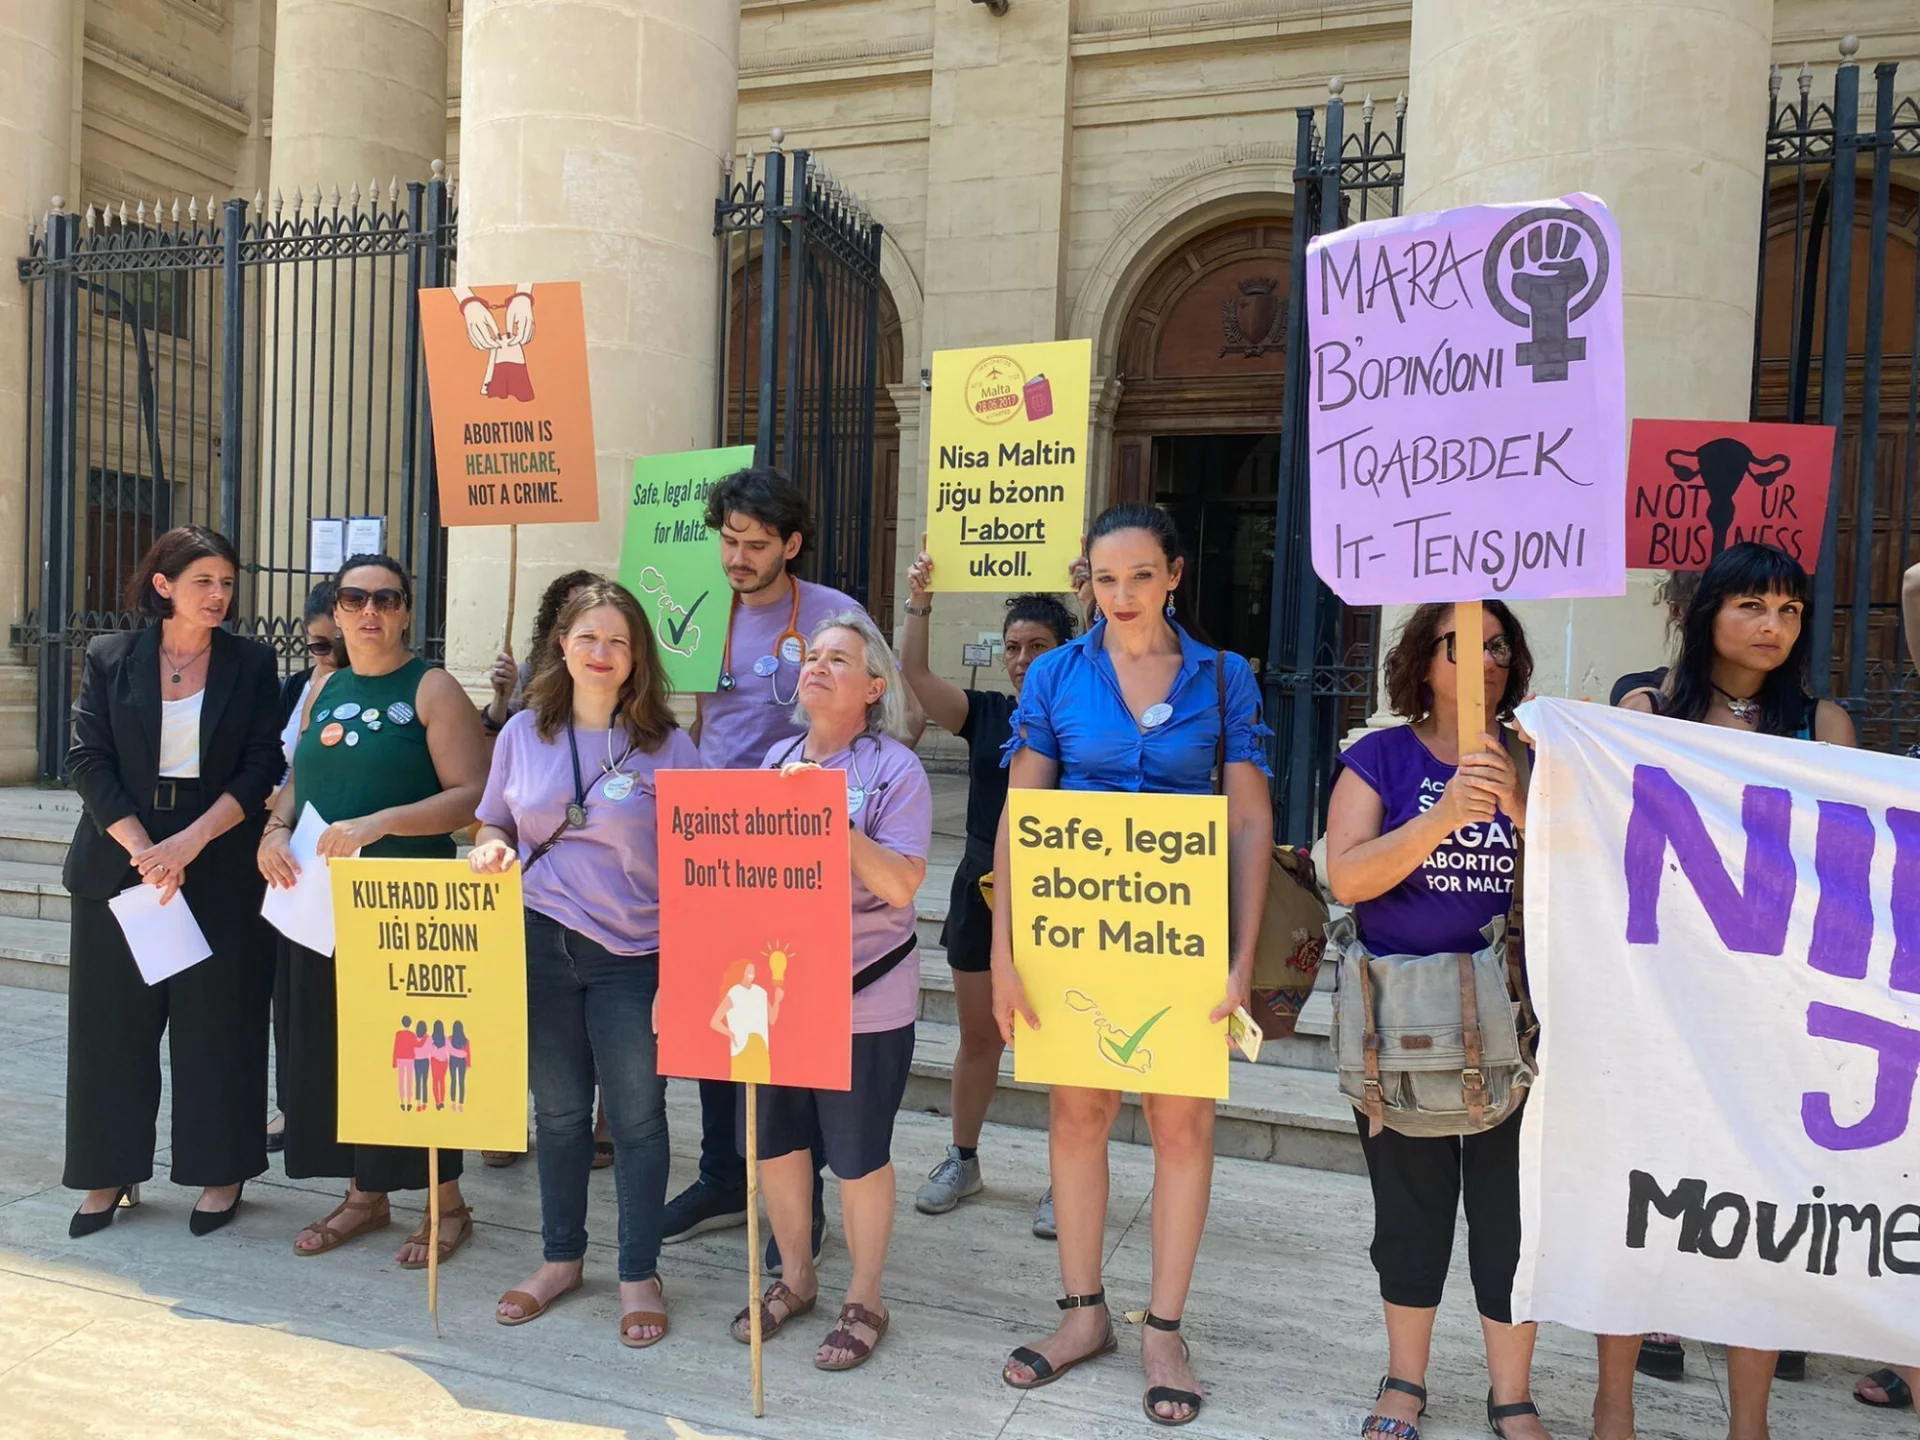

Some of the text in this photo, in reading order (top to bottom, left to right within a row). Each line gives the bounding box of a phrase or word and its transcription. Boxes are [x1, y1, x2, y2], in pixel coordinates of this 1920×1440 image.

[1320, 231, 1483, 323] MARA
[981, 385, 1011, 398] Malta
[464, 420, 553, 445] ABORTION IS
[465, 451, 561, 475] HEALTHCARE,
[940, 440, 1075, 469] Nisa Maltin
[1317, 426, 1594, 498] TQABBDEK
[468, 482, 563, 506] NOT A CRIME.
[634, 482, 661, 506] Safe,
[663, 479, 692, 507] legal
[936, 480, 1064, 512] jiġu bżonn
[1635, 483, 1798, 519] NOT UR
[654, 520, 708, 544] for Malta.
[970, 551, 1032, 577] ukoll.
[672, 805, 833, 841] Against abortion?
[1018, 815, 1216, 864] Safe, legal
[684, 857, 822, 890] Don't have one!
[1422, 851, 1517, 873] ABORTIO
[352, 880, 499, 911] KULĦADD JISTA'
[1031, 867, 1191, 906] abortion
[1425, 875, 1515, 893] FOR MALT
[379, 915, 479, 952] JIĠI BŻONN
[1031, 914, 1205, 957] for Malta
[388, 962, 472, 994] L-ABORT.
